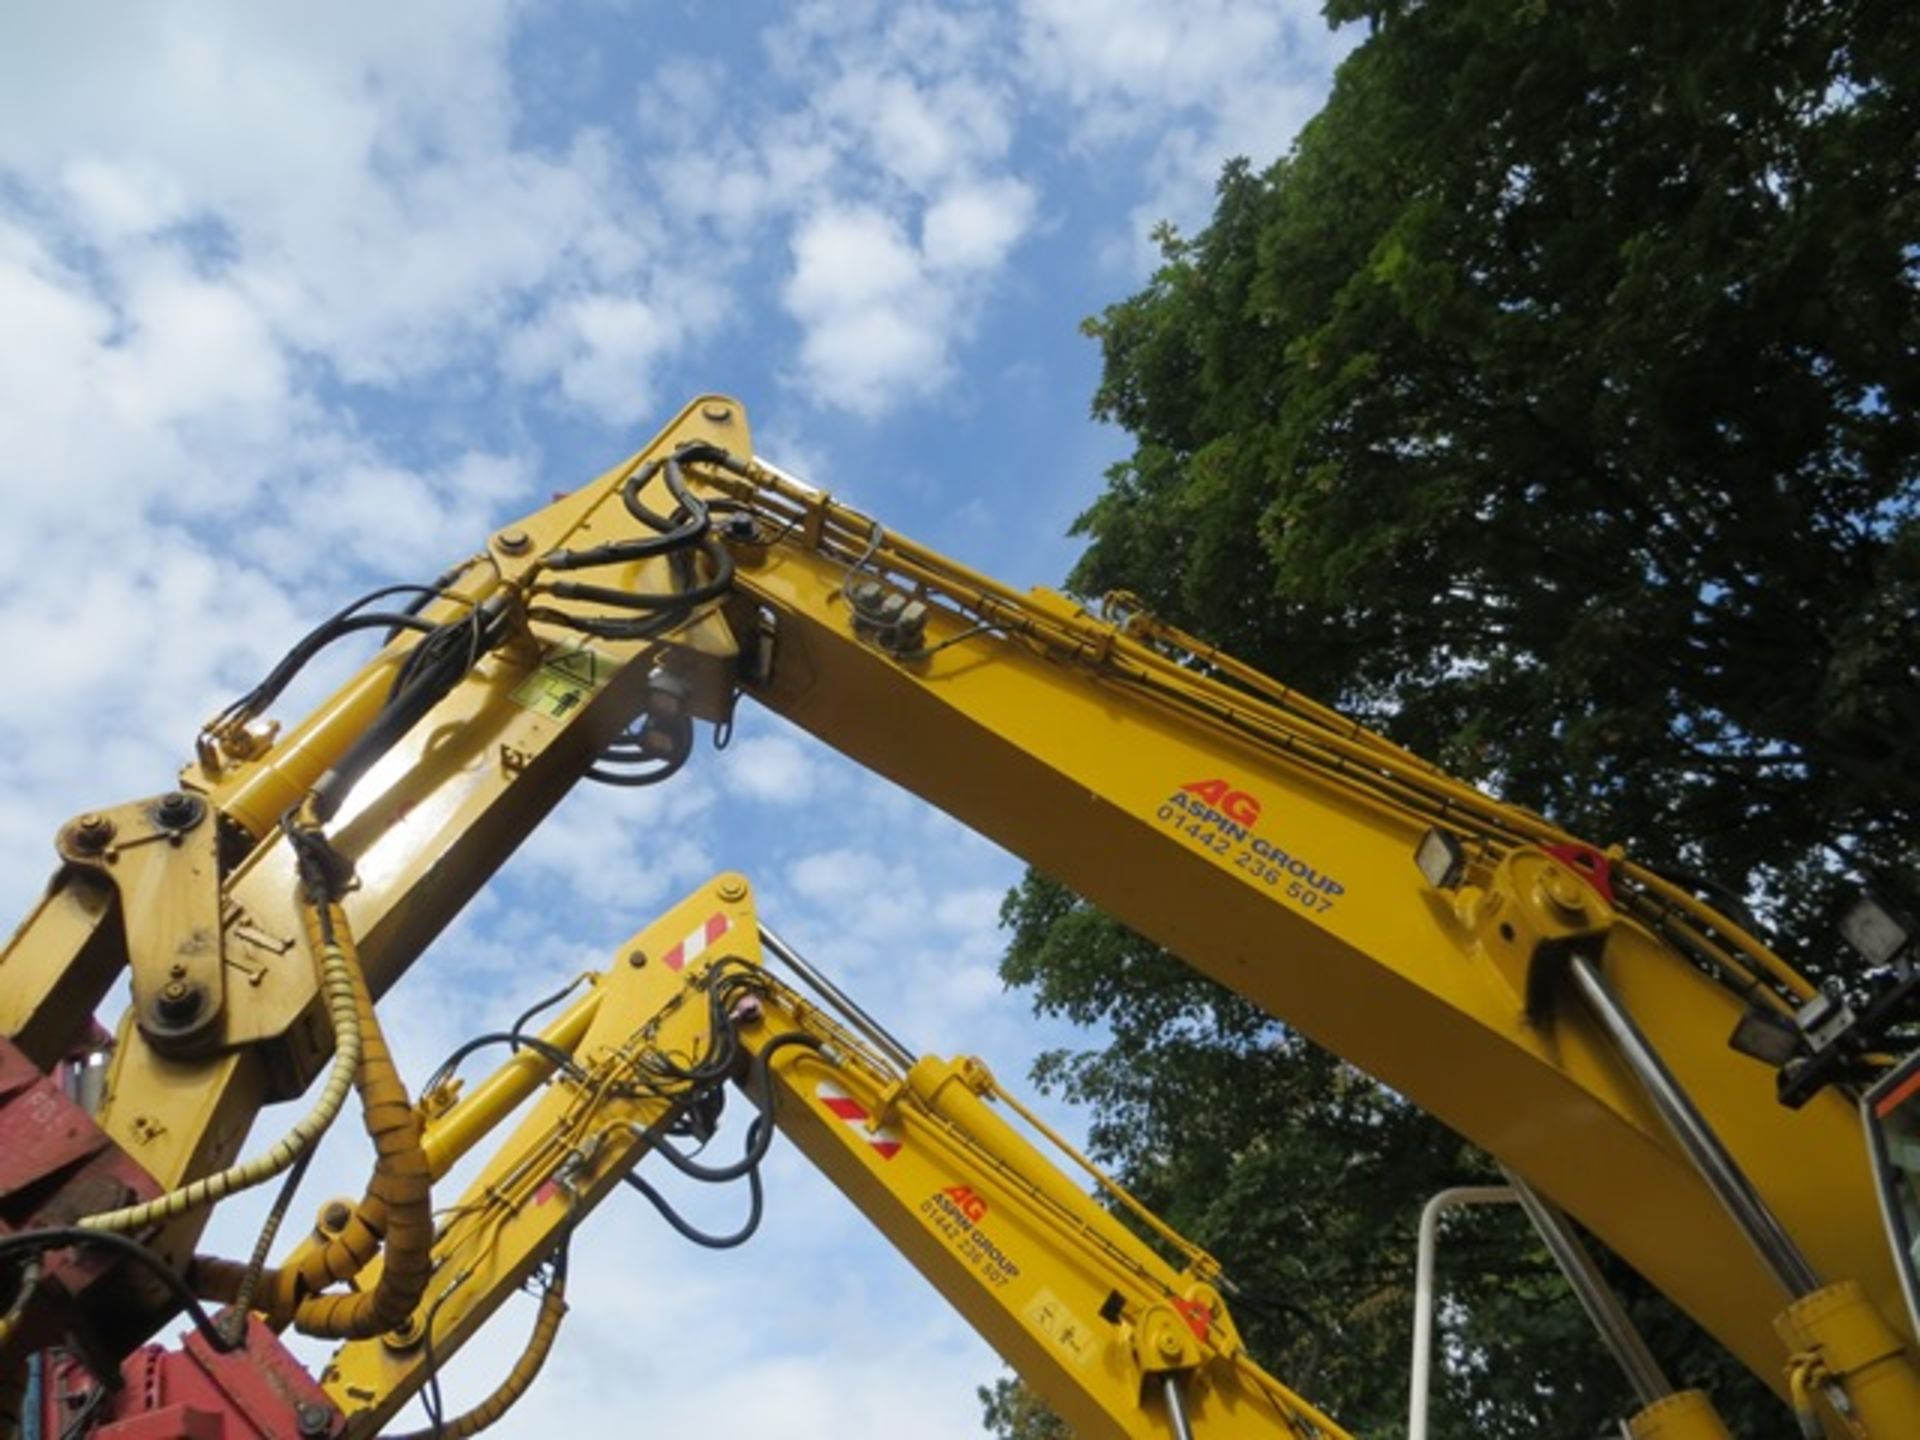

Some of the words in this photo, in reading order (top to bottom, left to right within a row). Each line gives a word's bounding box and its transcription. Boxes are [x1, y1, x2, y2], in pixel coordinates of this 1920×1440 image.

[1181, 780, 1260, 828] AG
[1157, 804, 1230, 855] 01442
[1234, 851, 1281, 885] 236
[1285, 881, 1334, 913] 507
[1170, 792, 1247, 842] ASPIN
[1252, 839, 1344, 895] GROUP
[933, 1193, 972, 1230] ASPIN
[972, 1230, 1019, 1276] GROUP
[942, 1186, 987, 1221] AG
[983, 1263, 1008, 1286] 507
